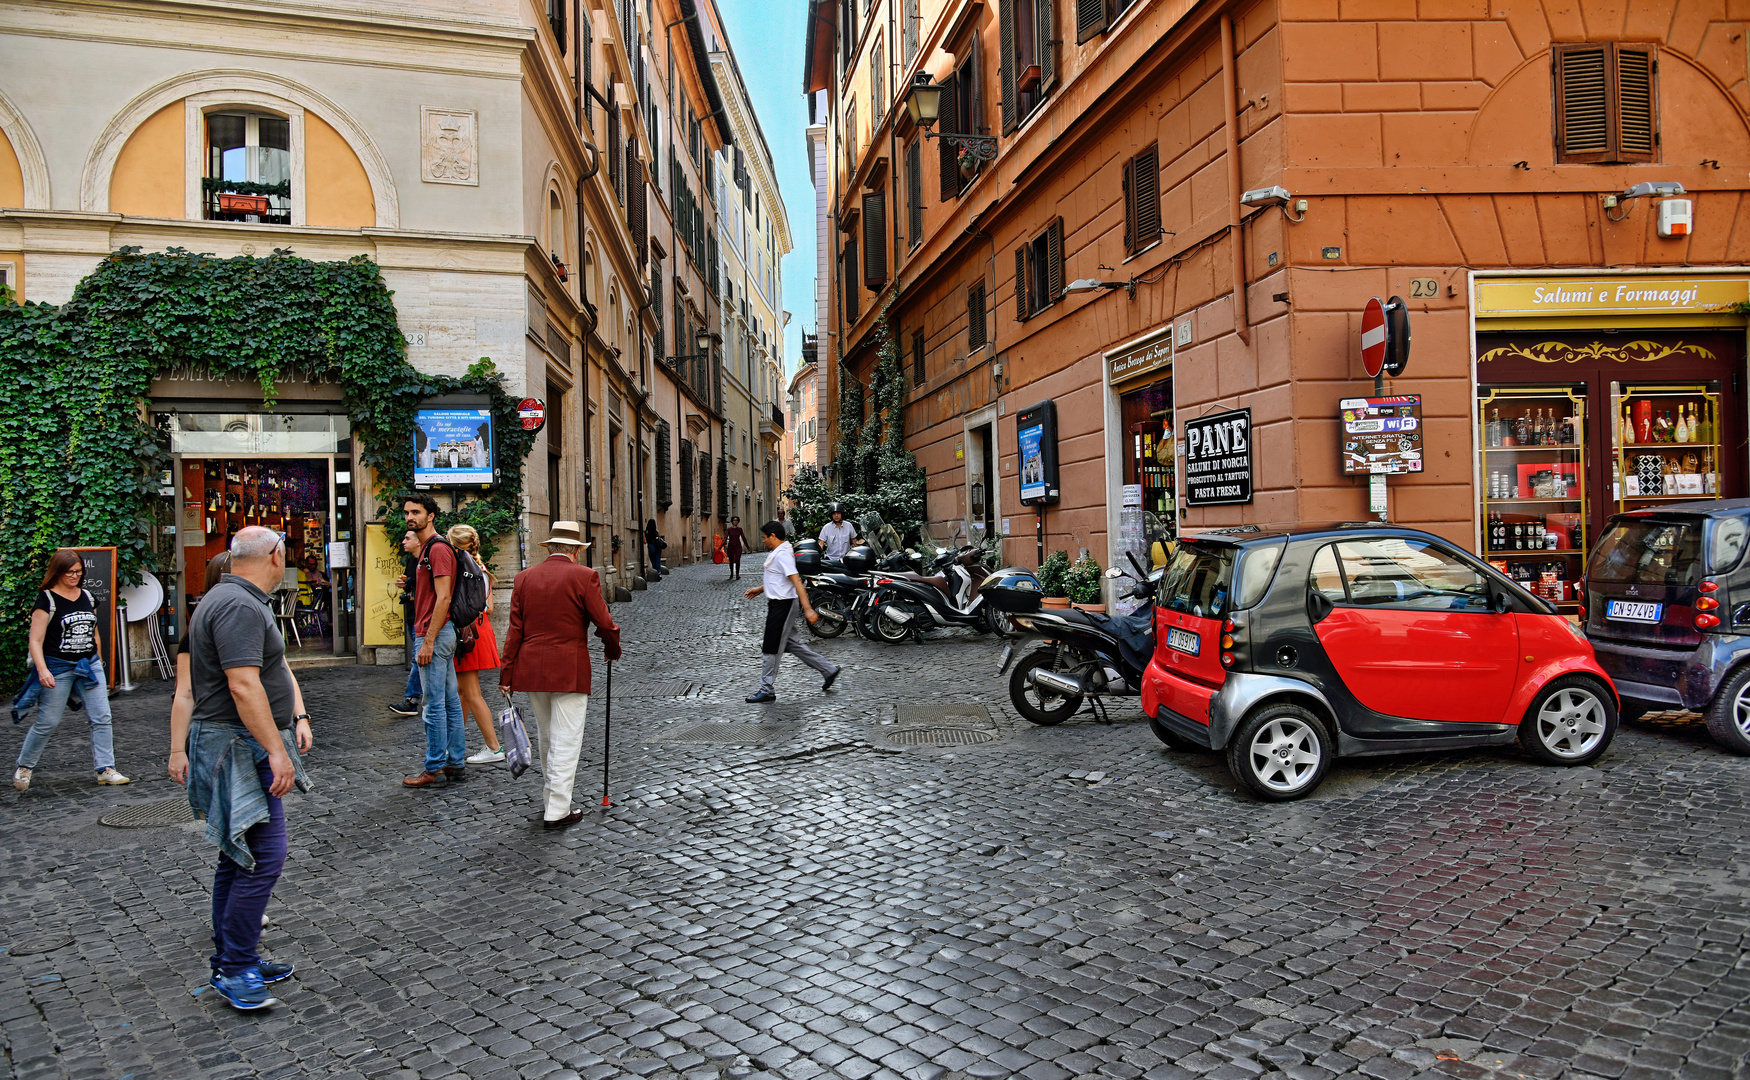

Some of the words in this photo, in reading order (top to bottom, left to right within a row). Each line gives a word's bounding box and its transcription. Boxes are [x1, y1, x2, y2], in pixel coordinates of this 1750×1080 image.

[1411, 279, 1438, 297] 29
[1532, 286, 1594, 304] Salumi
[1598, 289, 1609, 302] e
[1615, 284, 1699, 306] Formaggi
[406, 333, 424, 346] 28
[1112, 361, 1127, 374] Antica
[1145, 349, 1154, 361] dei
[1153, 343, 1170, 359] Sapori
[1187, 418, 1247, 460] PANE
[1187, 461, 1211, 473] SALUMI
[1212, 460, 1221, 470] DI
[1221, 456, 1248, 470] NORCIA
[1187, 474, 1217, 485] PROSCIUTTO
[1217, 473, 1224, 482] AL
[1224, 471, 1249, 481] TARTUFO
[1194, 487, 1215, 498] PASTA
[1216, 485, 1241, 497] FRESCA
[1613, 602, 1626, 616] CN
[1626, 603, 1655, 618] 974VB
[64, 614, 96, 624] VINTAGE
[72, 624, 89, 634] 1969
